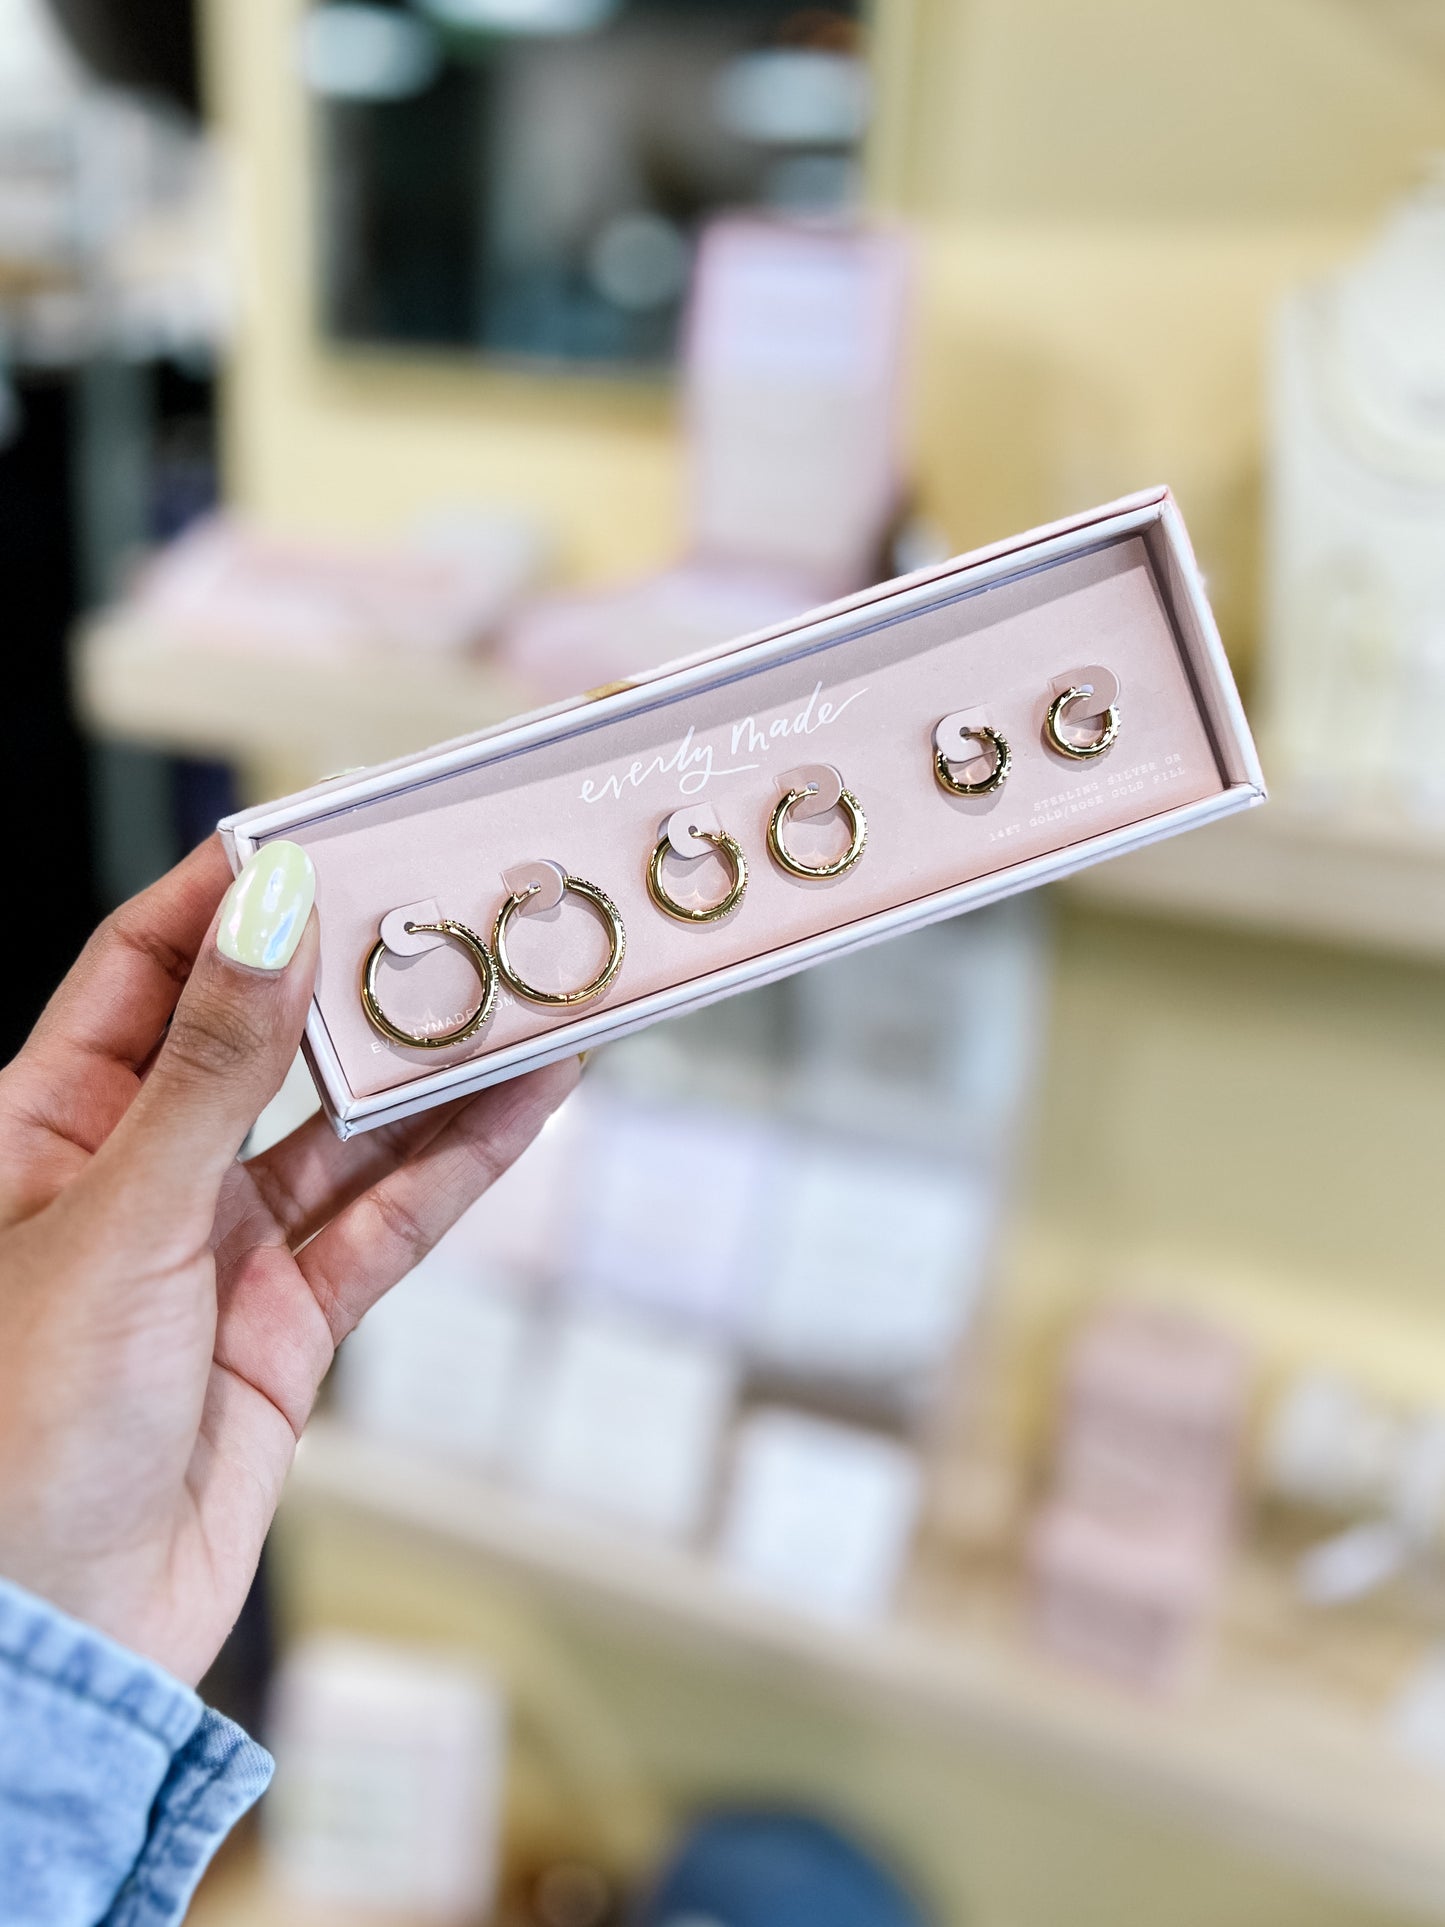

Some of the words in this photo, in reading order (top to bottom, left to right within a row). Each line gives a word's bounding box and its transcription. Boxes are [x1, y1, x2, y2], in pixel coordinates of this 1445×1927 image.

[577, 725, 760, 804] everly
[1033, 781, 1099, 812] STERLING
[1107, 762, 1156, 786] SILVER
[1164, 753, 1182, 766] OR
[1029, 795, 1104, 827] GOLD/ROSE
[1111, 781, 1144, 799] GOLD
[1153, 767, 1186, 785] FILL
